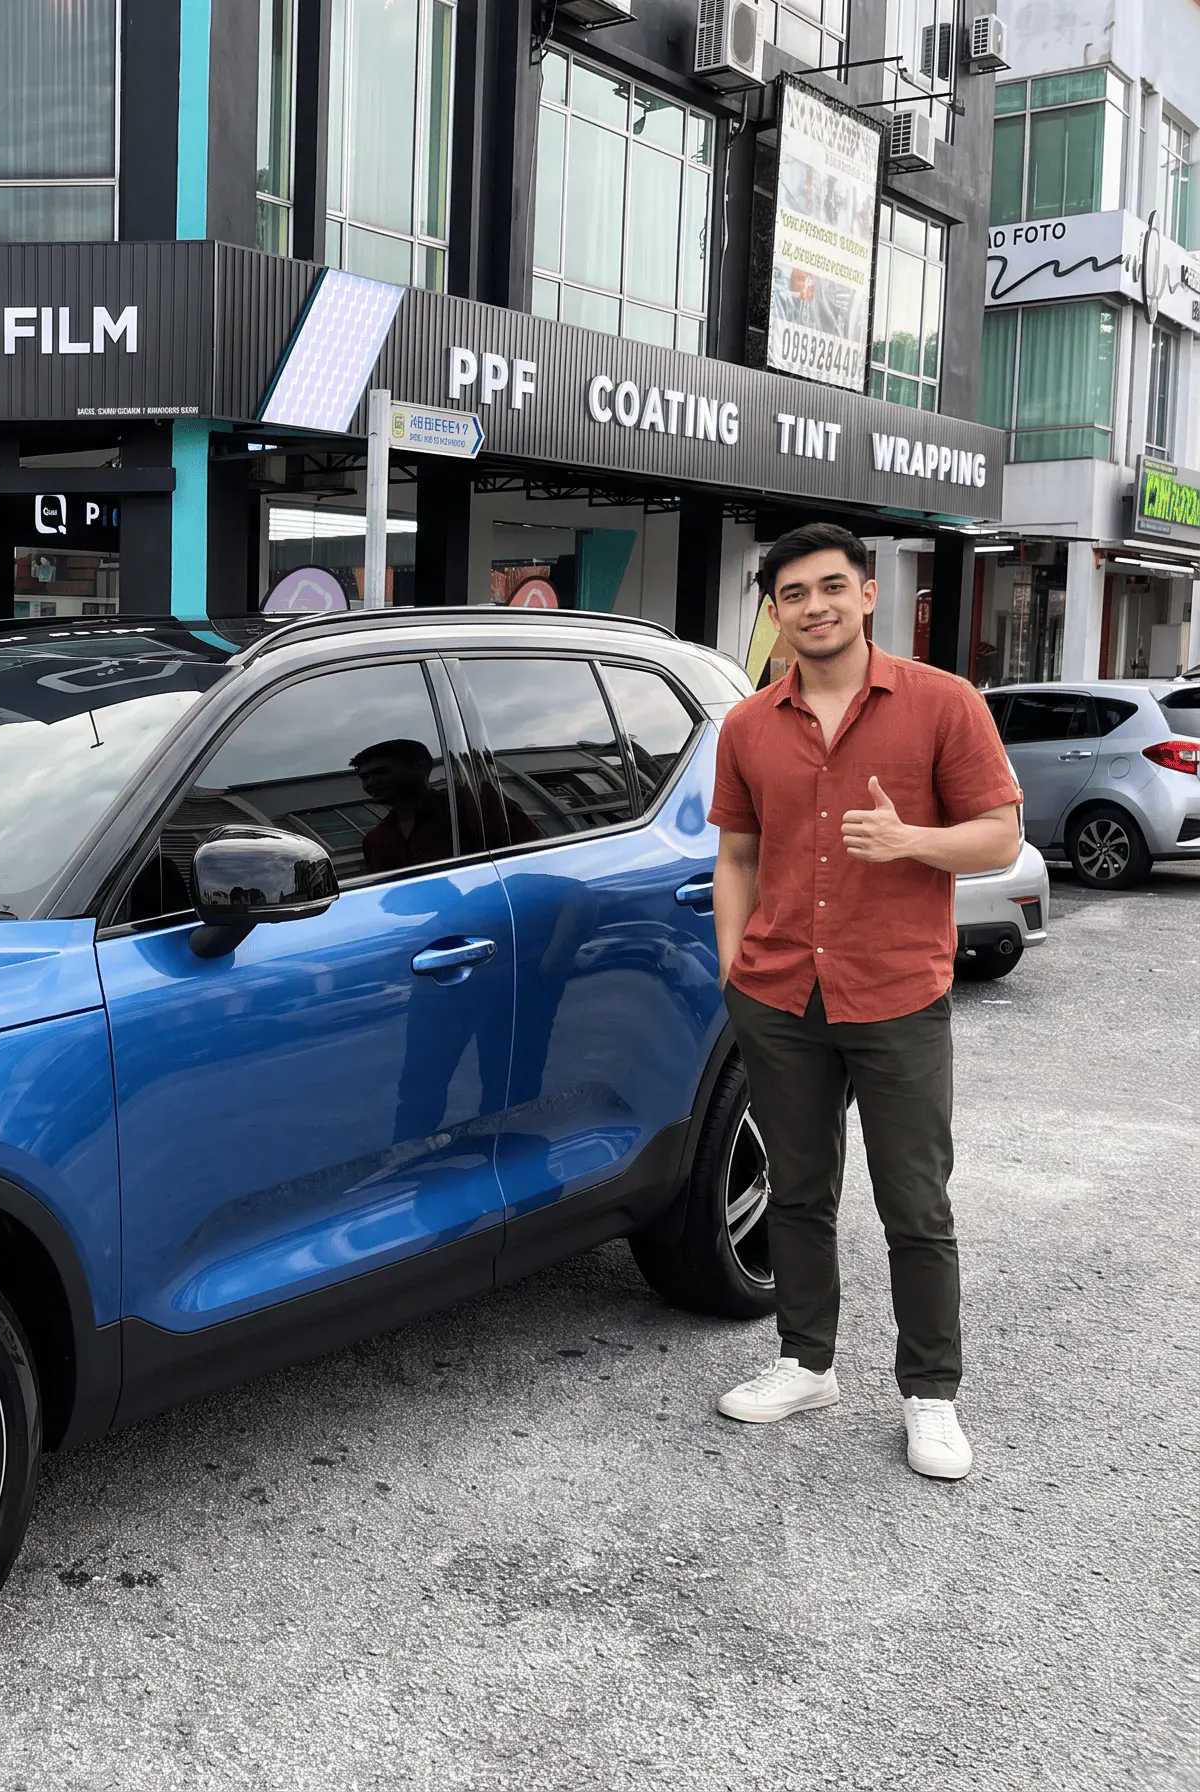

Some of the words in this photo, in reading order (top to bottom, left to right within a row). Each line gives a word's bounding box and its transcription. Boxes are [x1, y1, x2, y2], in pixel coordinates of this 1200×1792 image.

[1013, 222, 1067, 246] FOTO
[3, 305, 139, 356] FILM
[448, 346, 537, 411] PPF
[588, 374, 740, 446] COATING
[776, 412, 842, 462] TINT
[871, 432, 987, 489] WRAPPING
